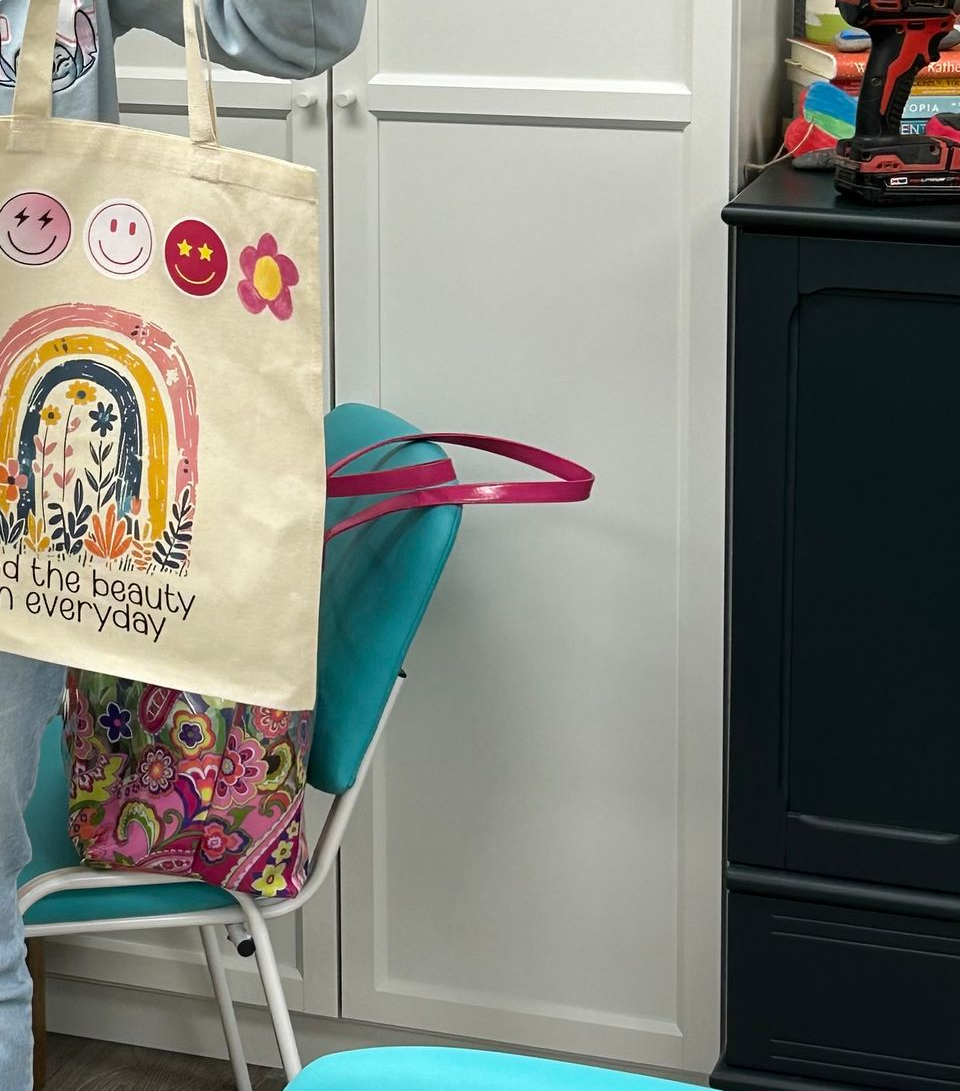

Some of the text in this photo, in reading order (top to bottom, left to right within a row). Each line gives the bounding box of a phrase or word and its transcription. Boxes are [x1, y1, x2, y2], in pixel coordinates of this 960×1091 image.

[26, 591, 167, 643] everyday
[31, 557, 80, 594] the
[92, 569, 196, 621] beauty
